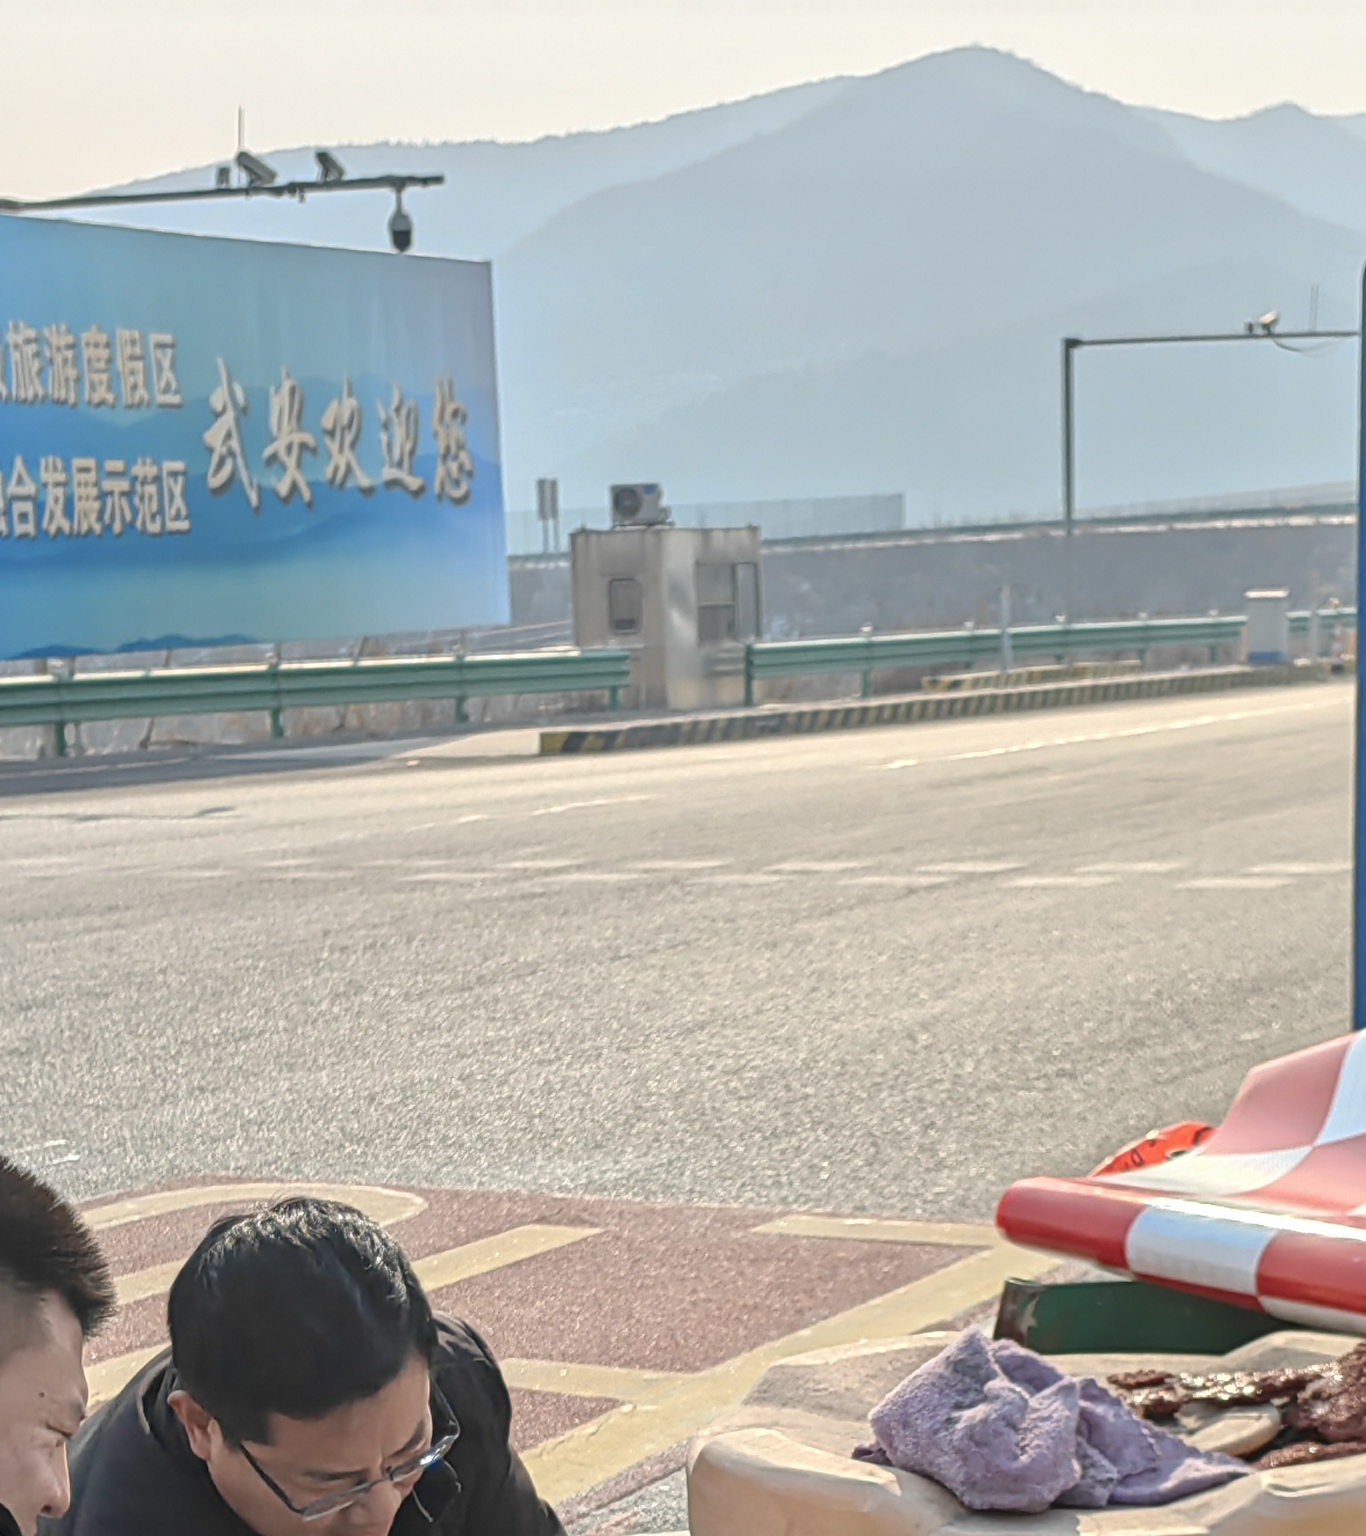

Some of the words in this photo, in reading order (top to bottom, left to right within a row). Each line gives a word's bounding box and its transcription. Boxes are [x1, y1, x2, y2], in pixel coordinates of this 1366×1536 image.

[192, 355, 475, 512] 武安欢迎您
